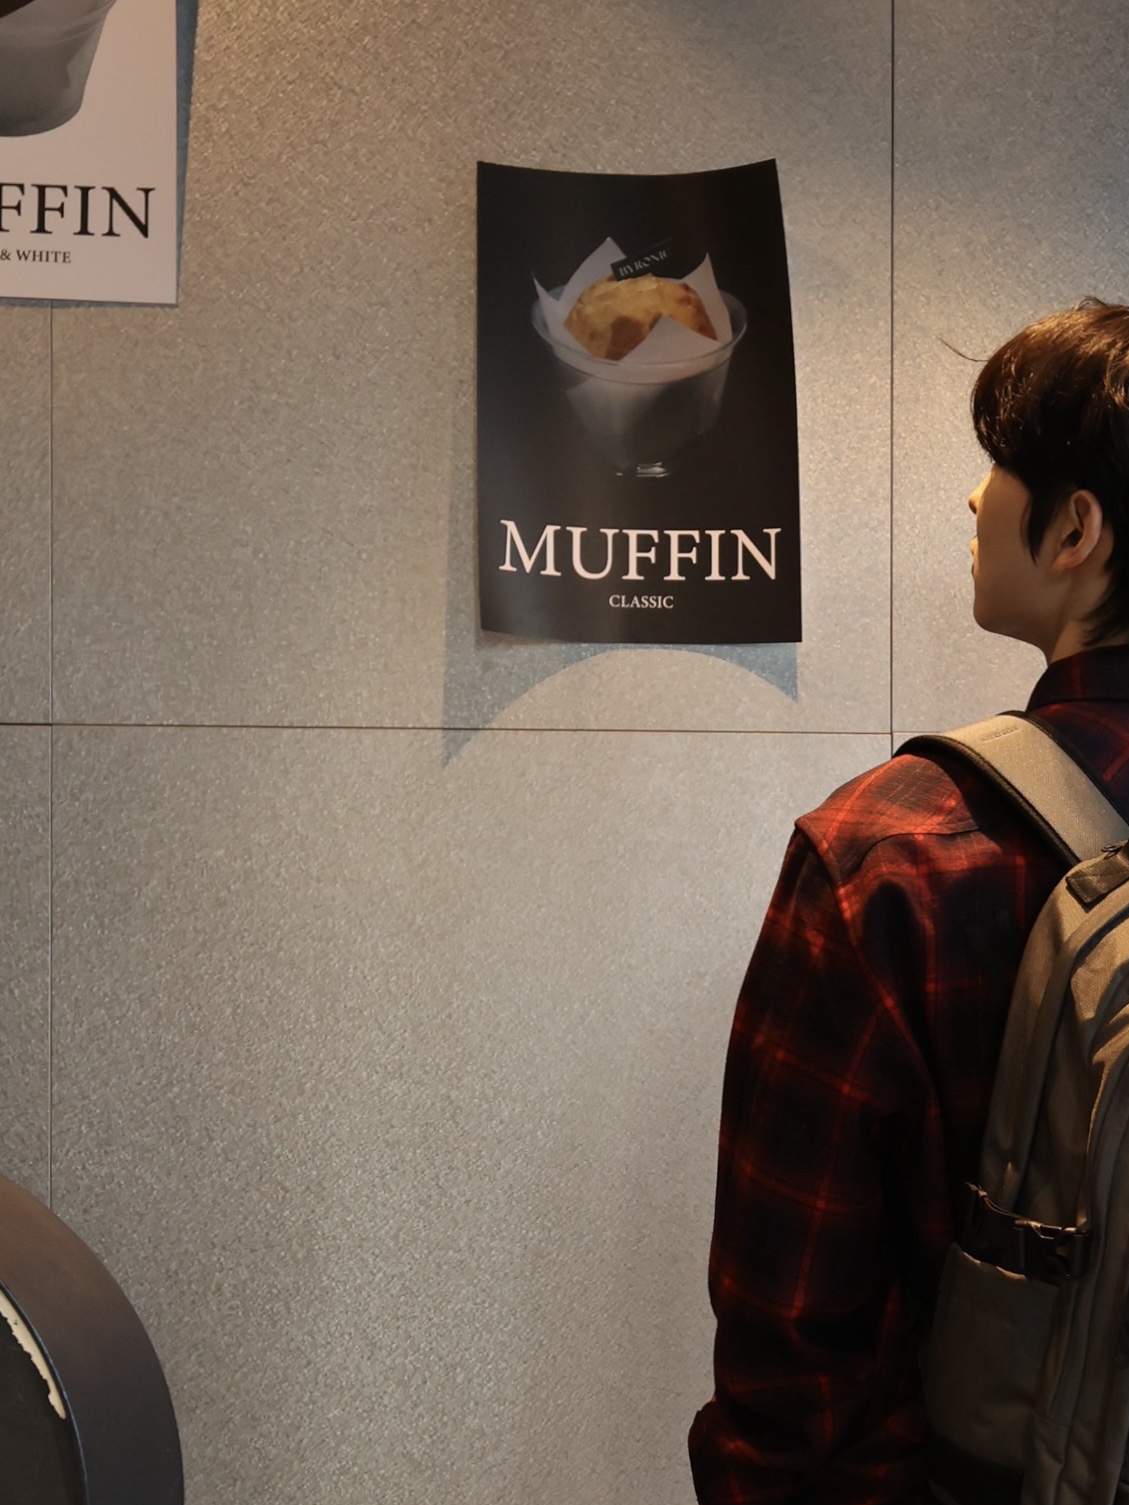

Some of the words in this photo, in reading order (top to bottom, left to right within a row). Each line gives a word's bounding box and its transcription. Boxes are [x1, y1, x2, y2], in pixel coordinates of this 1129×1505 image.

[16, 250, 72, 264] WHITE
[499, 519, 782, 581] MUFFIN
[609, 594, 674, 609] CLASSIC
